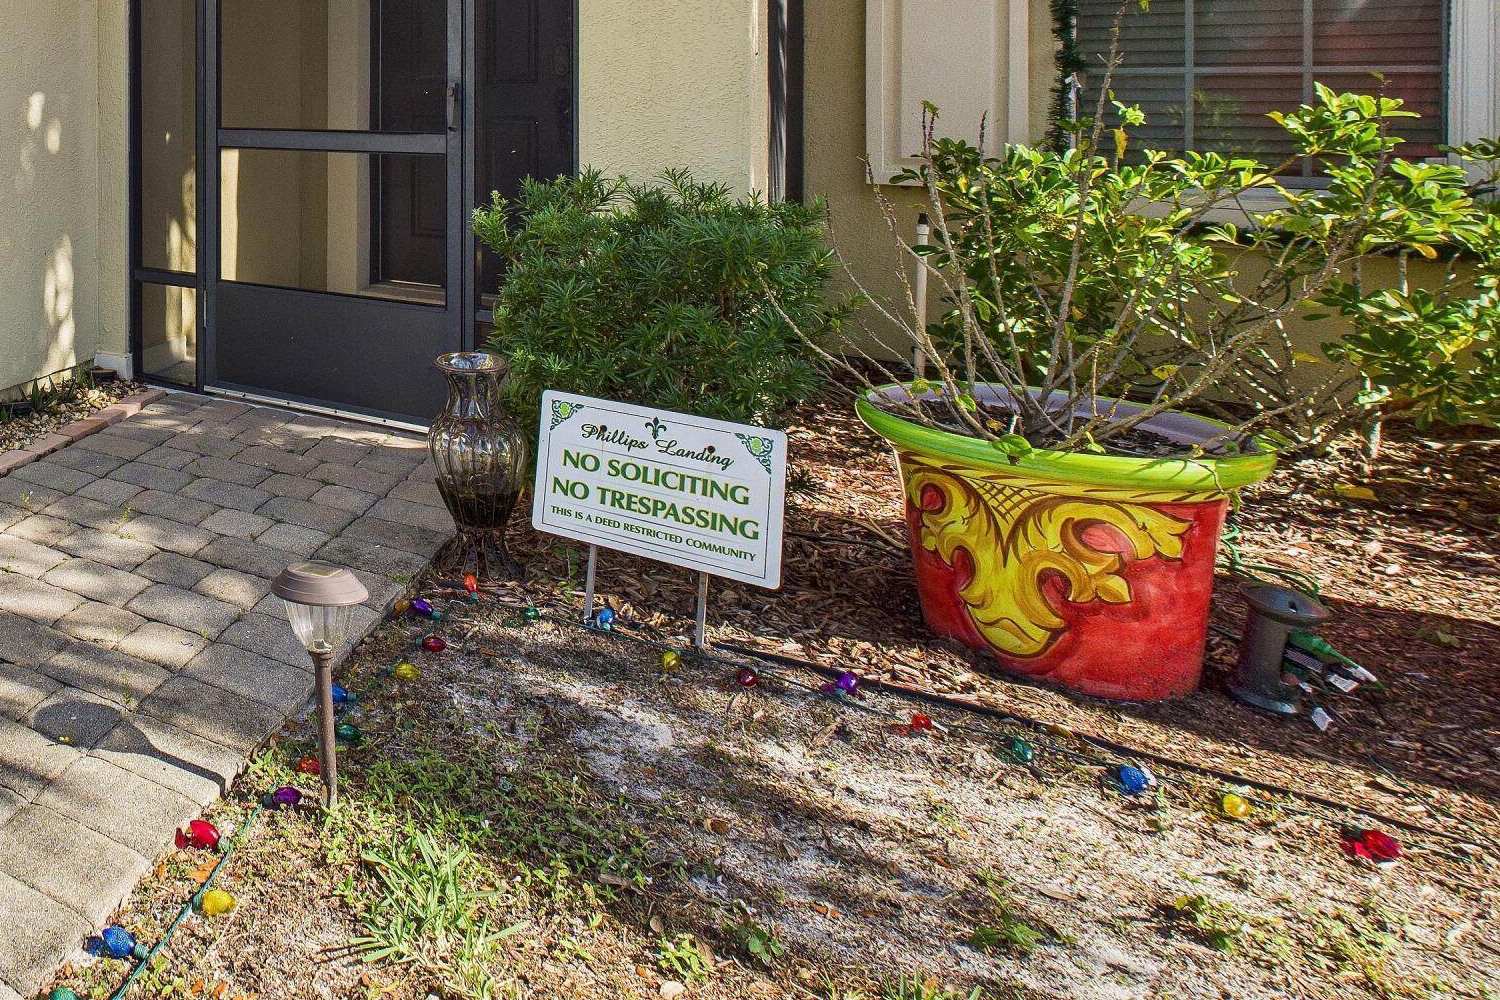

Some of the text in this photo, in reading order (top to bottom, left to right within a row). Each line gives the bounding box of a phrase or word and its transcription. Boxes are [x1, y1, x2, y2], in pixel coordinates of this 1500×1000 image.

[581, 423, 736, 471] Phillips Landing
[563, 450, 750, 505] NO SOLICITING
[551, 506, 756, 561] THIS IS A DEED RESTRICTED COMMUNITY
[552, 477, 759, 540] NO TRESPASSING
